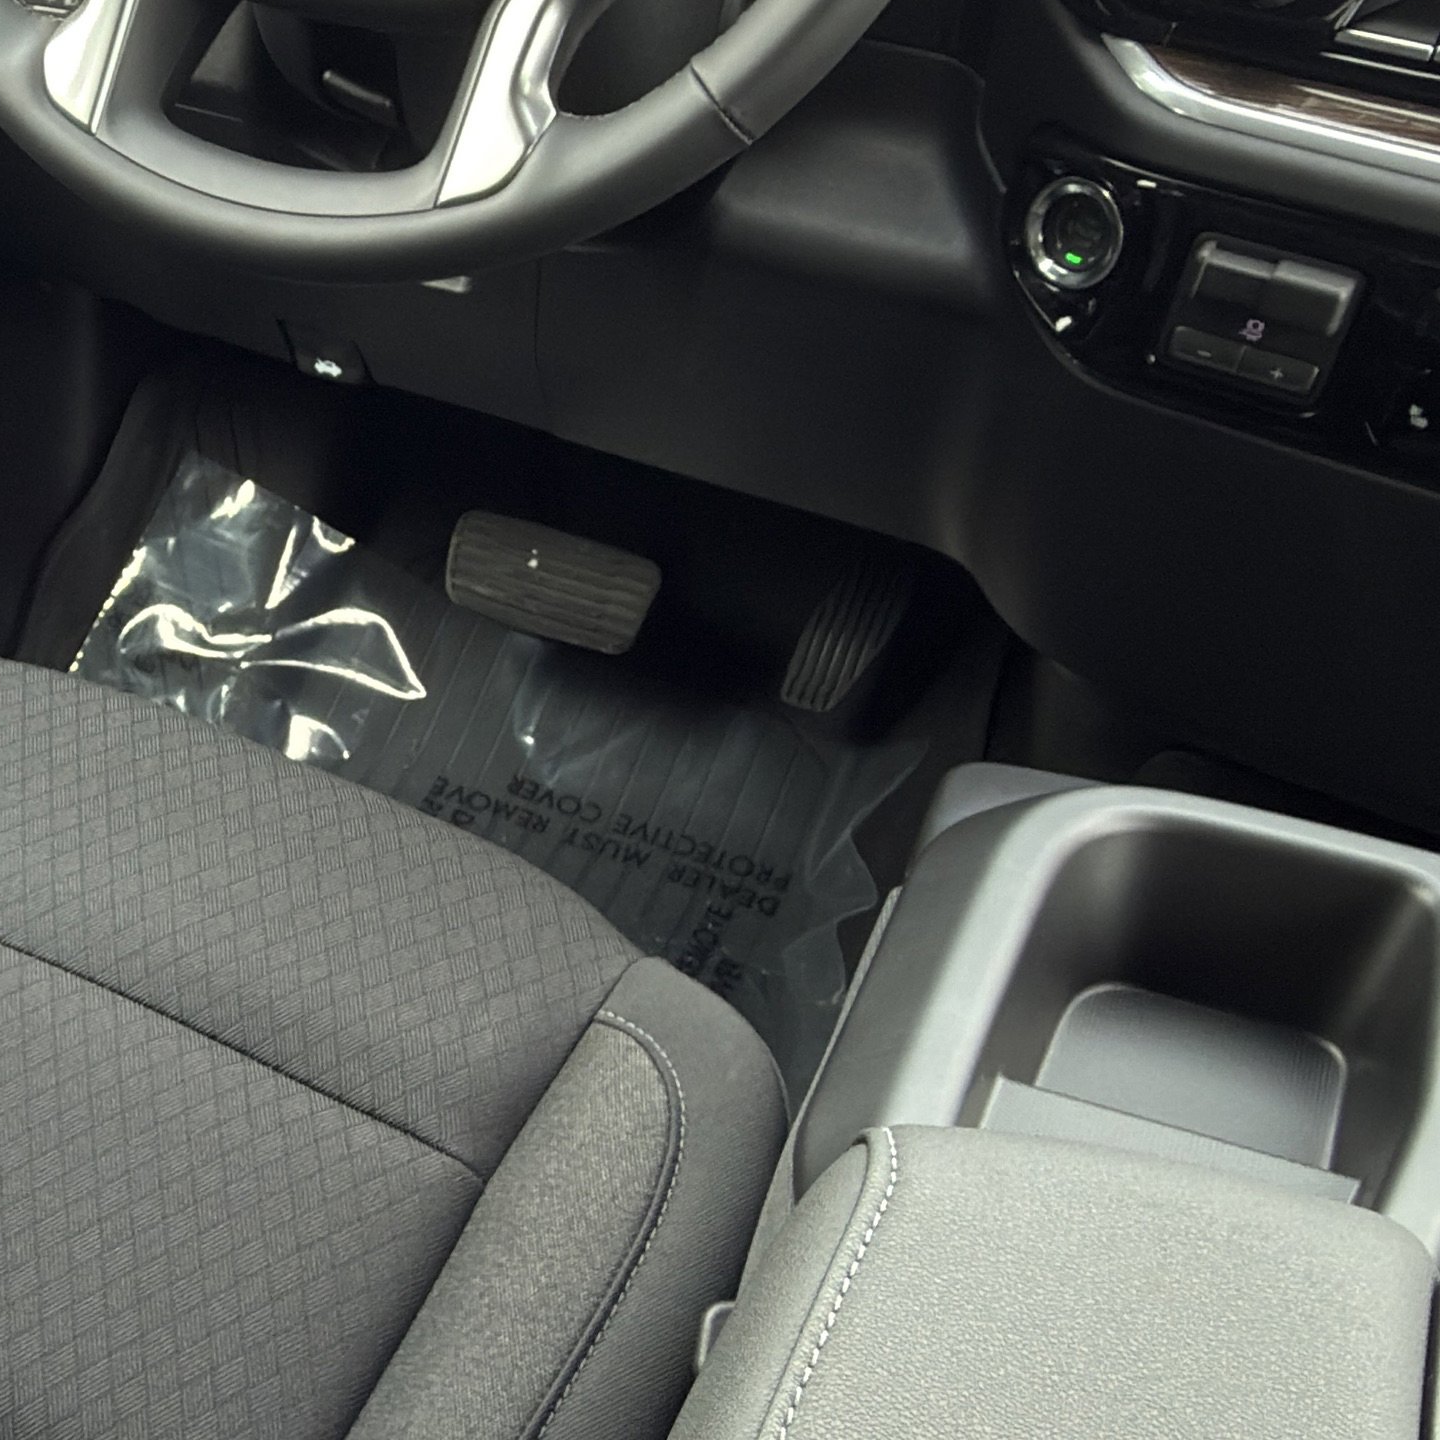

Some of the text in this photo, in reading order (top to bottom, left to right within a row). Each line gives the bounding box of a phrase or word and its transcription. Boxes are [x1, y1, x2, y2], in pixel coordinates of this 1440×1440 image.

[431, 774, 551, 835] REMOVE
[506, 774, 602, 824] COVER
[561, 826, 653, 869] MUST
[615, 812, 794, 893] PROTECTIVE
[667, 863, 782, 918] DEALER
